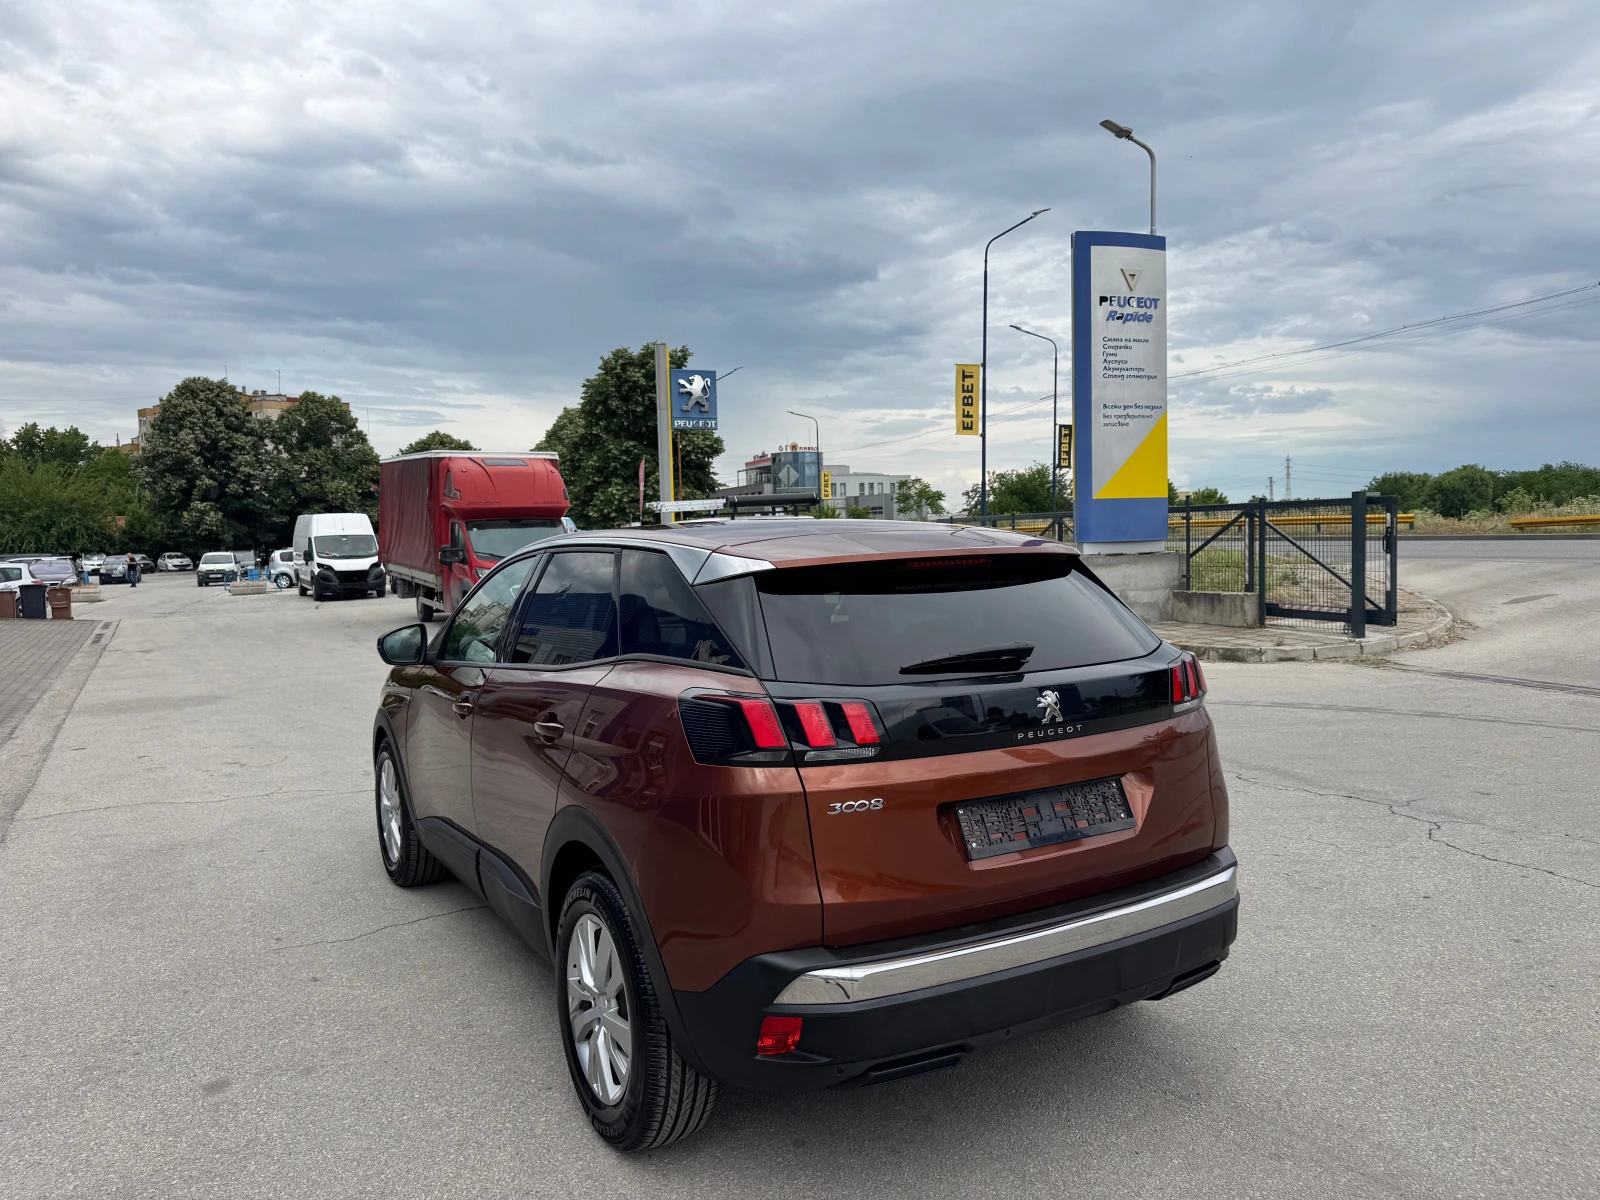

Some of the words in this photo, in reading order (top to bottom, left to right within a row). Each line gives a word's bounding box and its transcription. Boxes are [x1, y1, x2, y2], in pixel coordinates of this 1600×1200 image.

[1099, 295, 1160, 310] PEUGEOT
[1105, 310, 1154, 324] Rapide
[1102, 343, 1133, 351] Спирачки
[1102, 350, 1118, 358] Гуми
[1102, 358, 1128, 366] Ауспуси
[1102, 365, 1145, 373] Акумулатори
[1102, 372, 1125, 380] Стенд
[962, 369, 974, 431] EFBET
[1133, 402, 1144, 410] без
[674, 420, 716, 428] PEUGEOT
[1061, 427, 1070, 467] EFBET
[1017, 724, 1084, 740] PEUGEOT
[826, 798, 884, 816] 3008
